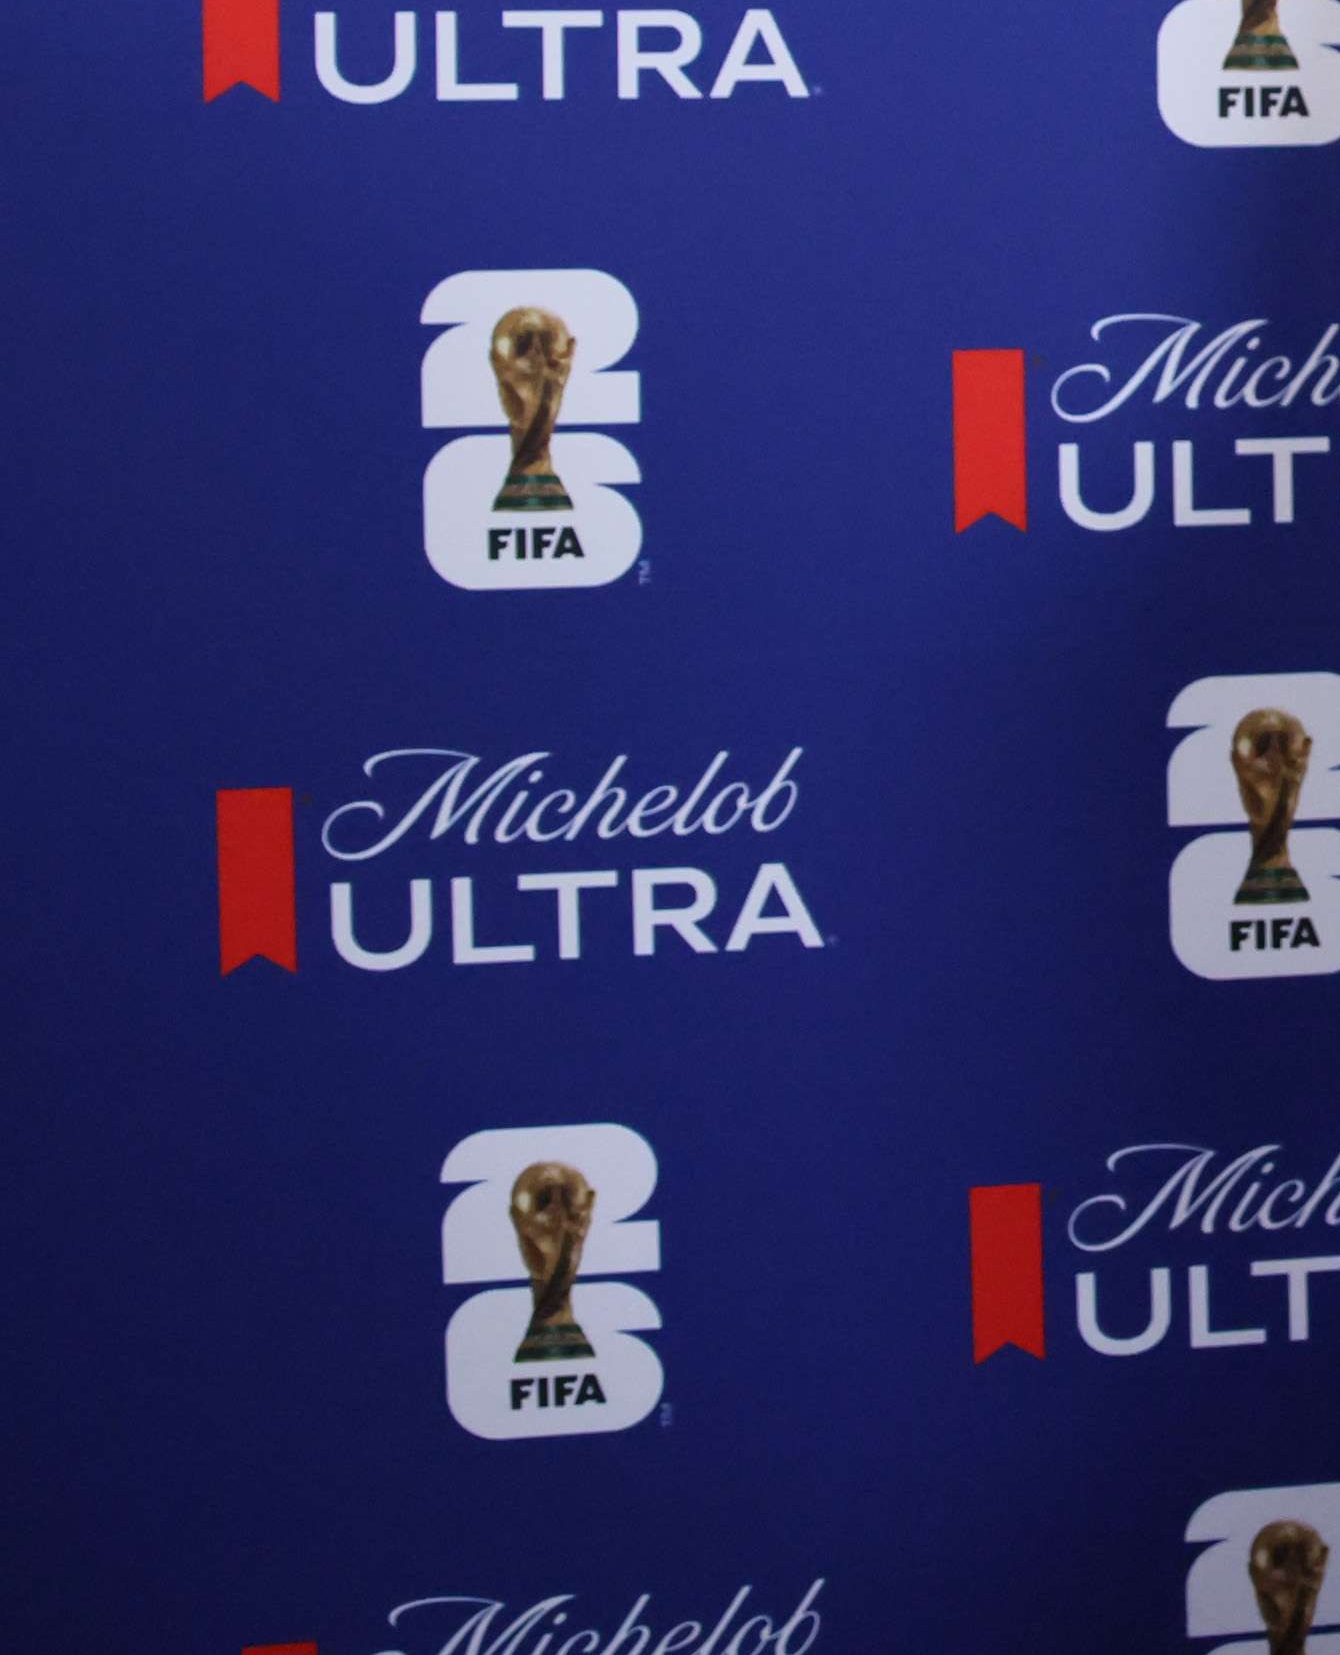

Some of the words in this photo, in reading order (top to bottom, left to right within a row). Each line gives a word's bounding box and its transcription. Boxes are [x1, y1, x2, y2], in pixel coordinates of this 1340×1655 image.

[315, 9, 810, 104] ULTRA
[1219, 86, 1309, 117] FIFA
[488, 527, 584, 560] FIFA
[322, 747, 803, 860] Michelob
[331, 863, 824, 971] ULTRA
[1230, 917, 1320, 951] FIFA
[511, 1374, 606, 1410] FIFA
